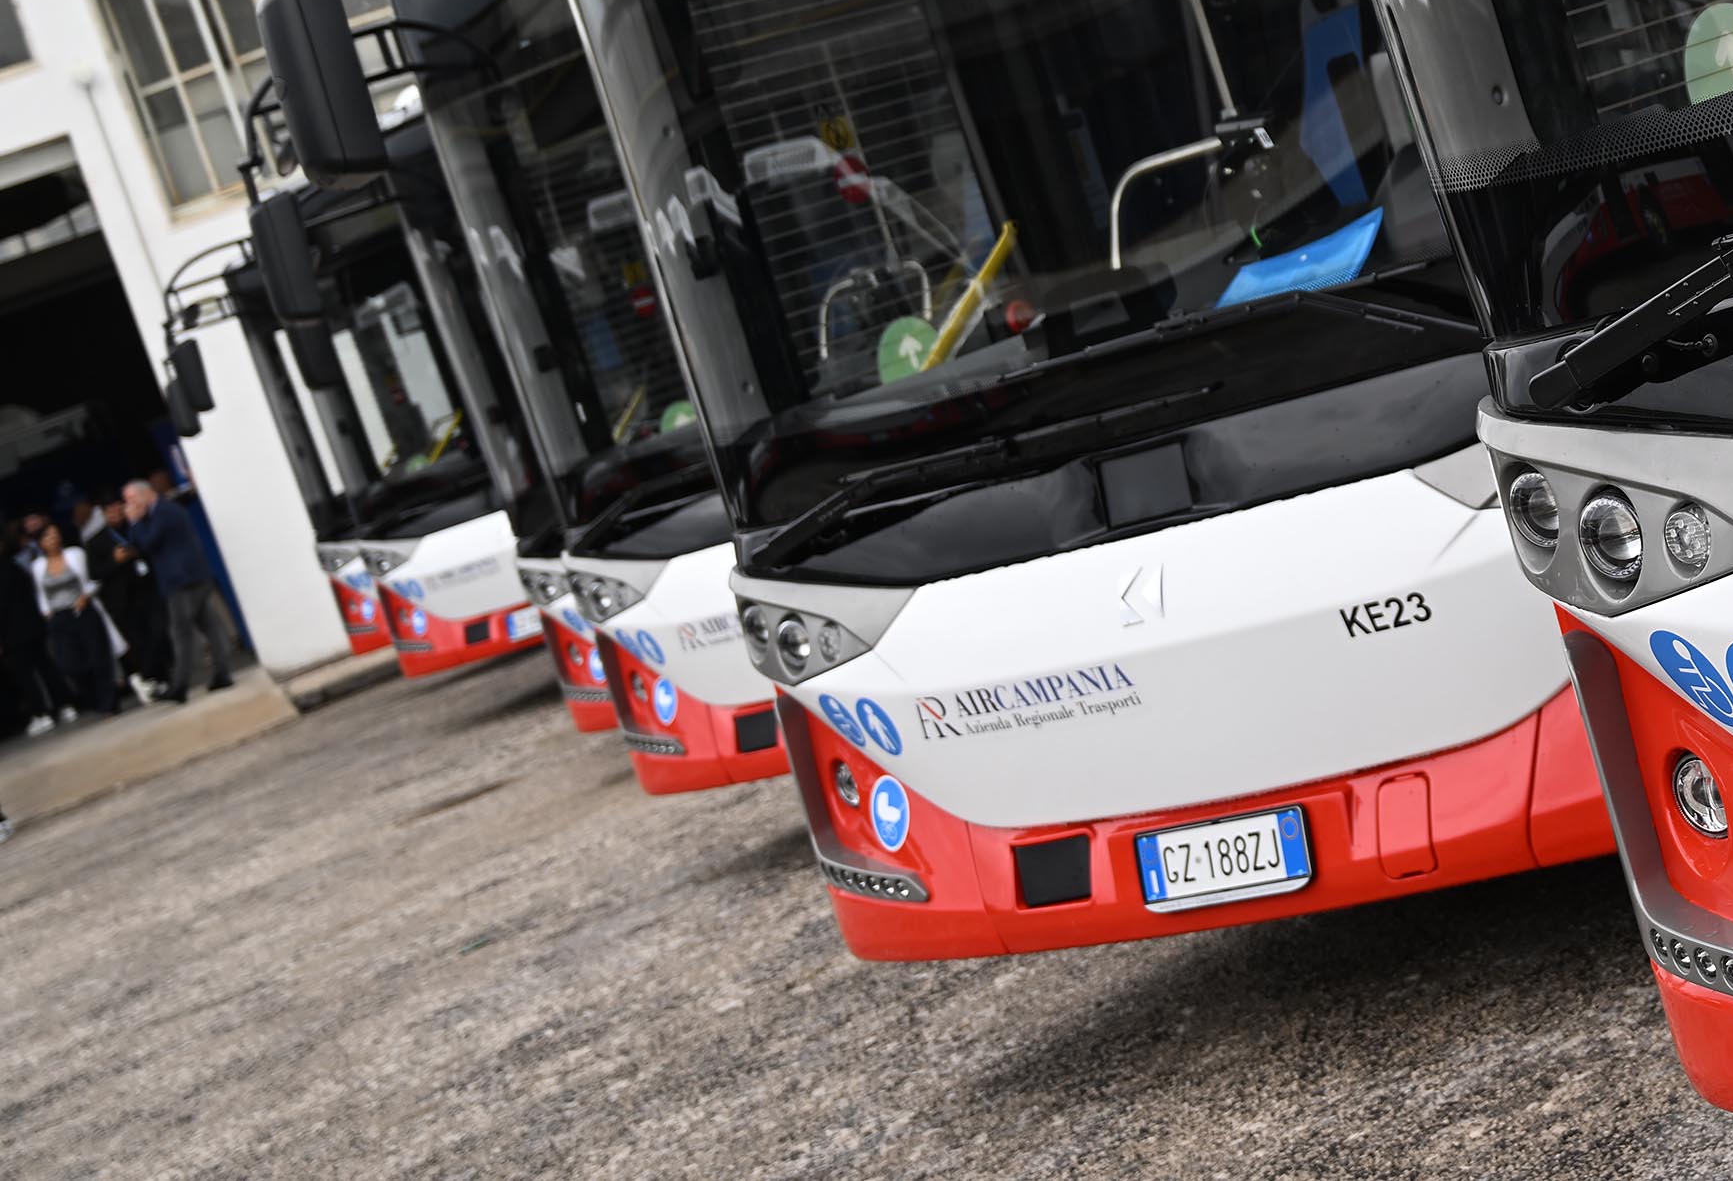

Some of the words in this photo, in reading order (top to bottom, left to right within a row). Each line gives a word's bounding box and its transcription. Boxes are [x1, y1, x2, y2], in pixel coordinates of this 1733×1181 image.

[1339, 591, 1432, 638] KE23
[954, 663, 1136, 718] AIRCAMPANIA
[964, 718, 1013, 736] Azienda
[1014, 708, 1075, 730] Regionale
[1077, 690, 1143, 717] Trasporti
